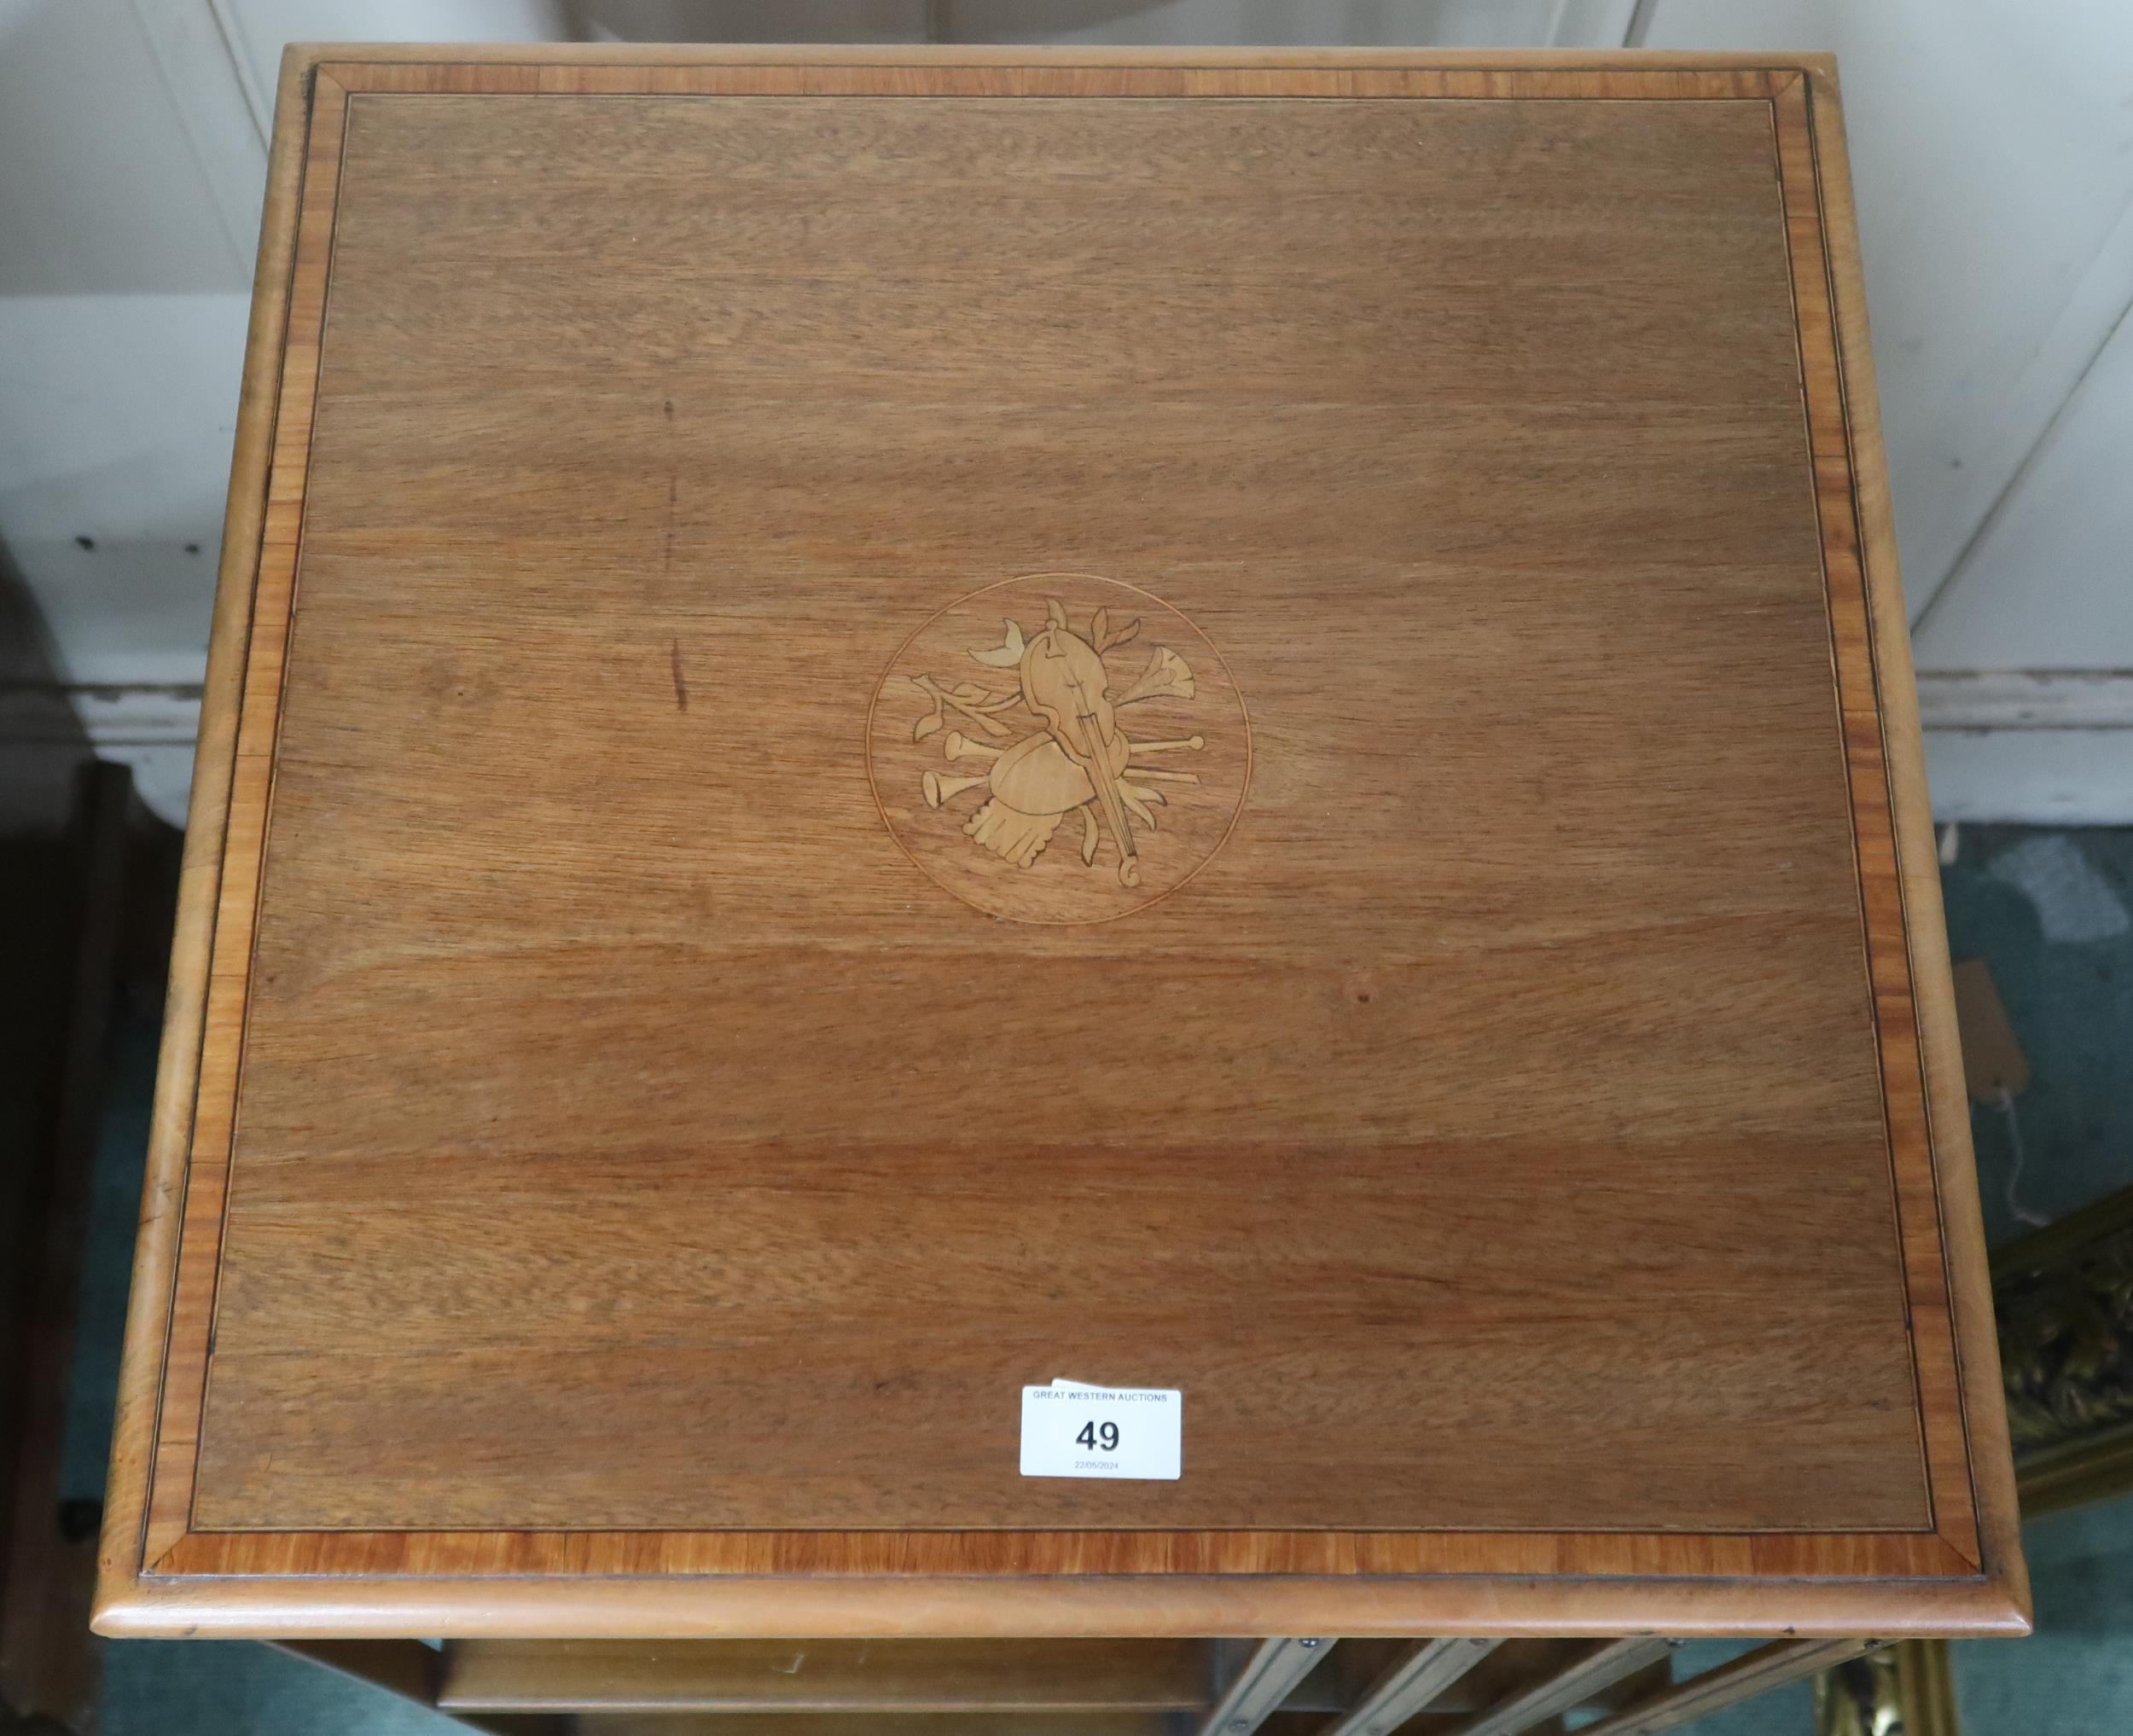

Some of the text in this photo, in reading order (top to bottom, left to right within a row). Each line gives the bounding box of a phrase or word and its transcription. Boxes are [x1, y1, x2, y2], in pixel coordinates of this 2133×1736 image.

[1032, 1391, 1167, 1402] GREAT WESTERN AUCTIONS
[1076, 1420, 1119, 1452] 49
[1074, 1460, 1119, 1470] 22/05/2024
